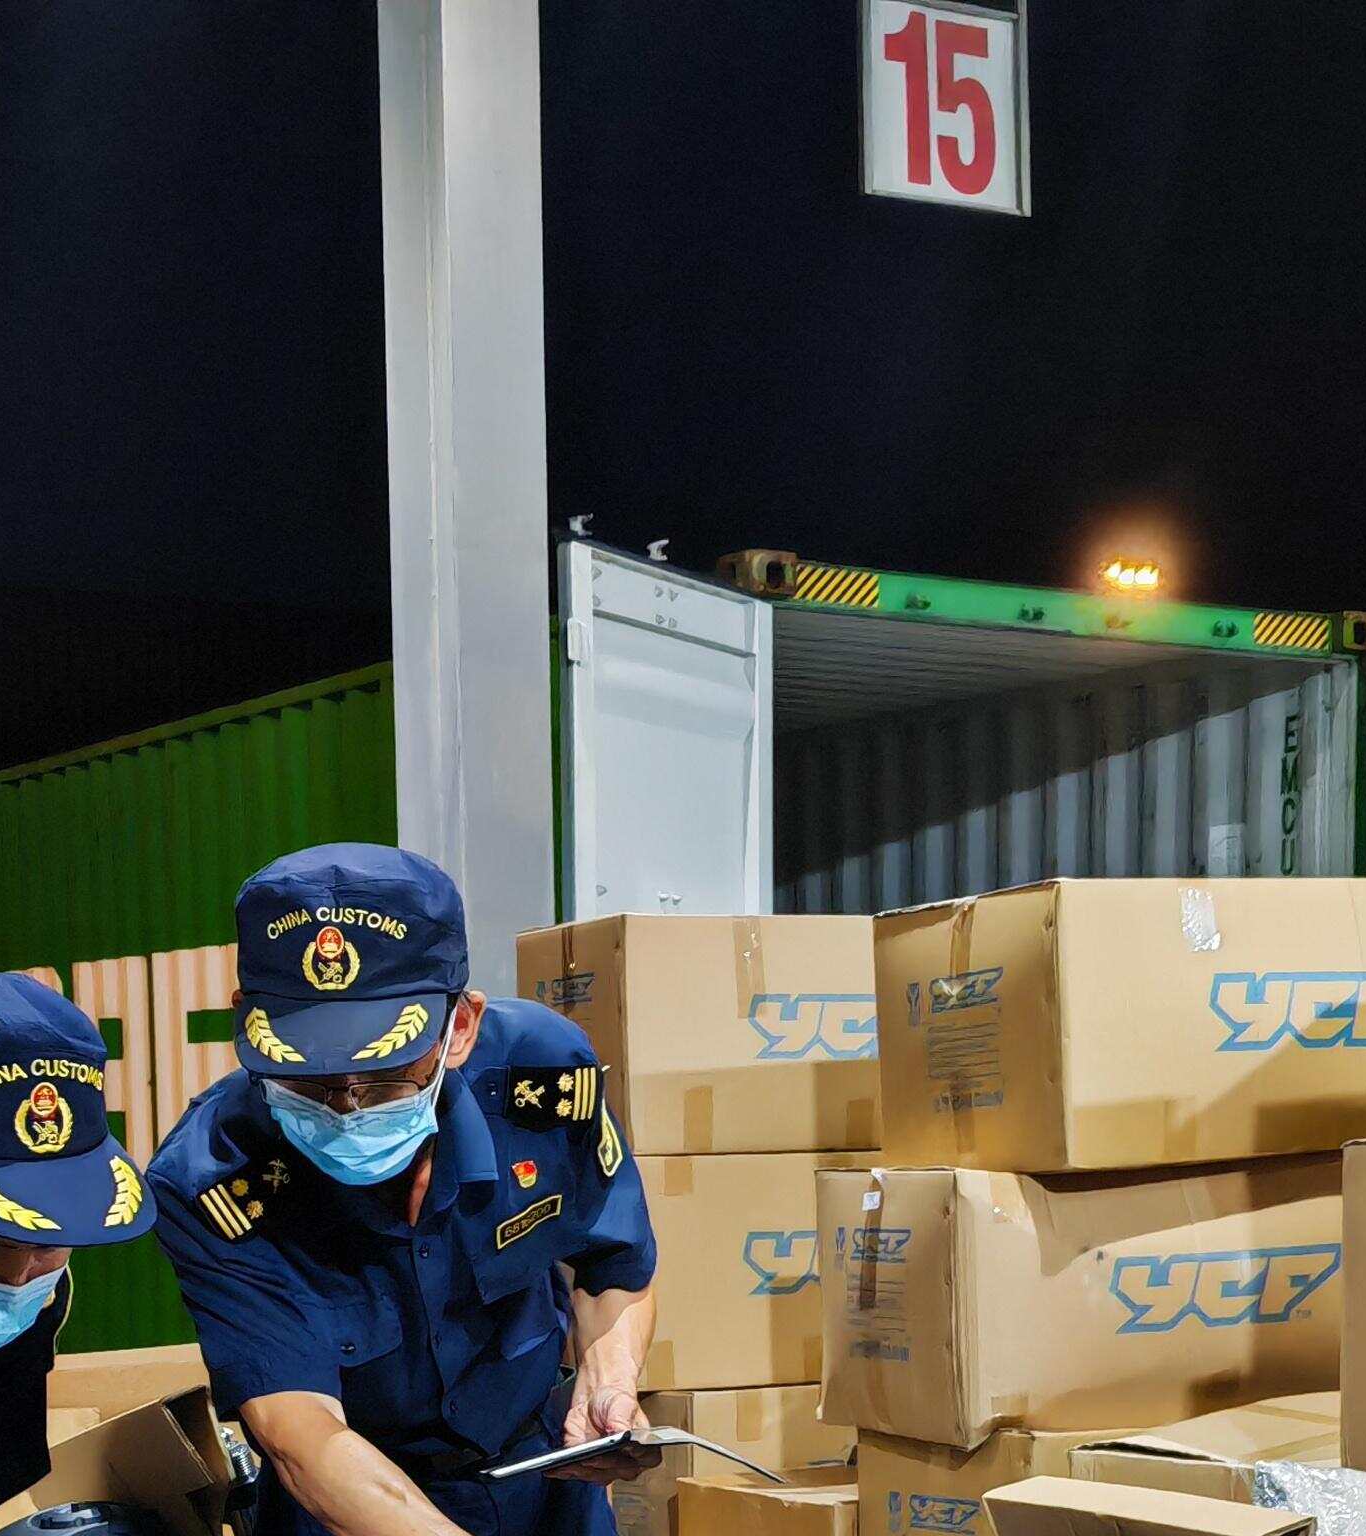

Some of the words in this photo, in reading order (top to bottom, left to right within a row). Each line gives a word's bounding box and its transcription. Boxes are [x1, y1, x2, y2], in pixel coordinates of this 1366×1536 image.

[883, 11, 996, 196] 15
[1280, 715, 1299, 876] EMCU
[267, 909, 312, 940] CHINA
[315, 906, 408, 940] CUSTOMS
[748, 993, 879, 1060] YC
[30, 1058, 104, 1092] CUSTOMS
[1110, 1242, 1341, 1334] YCF
